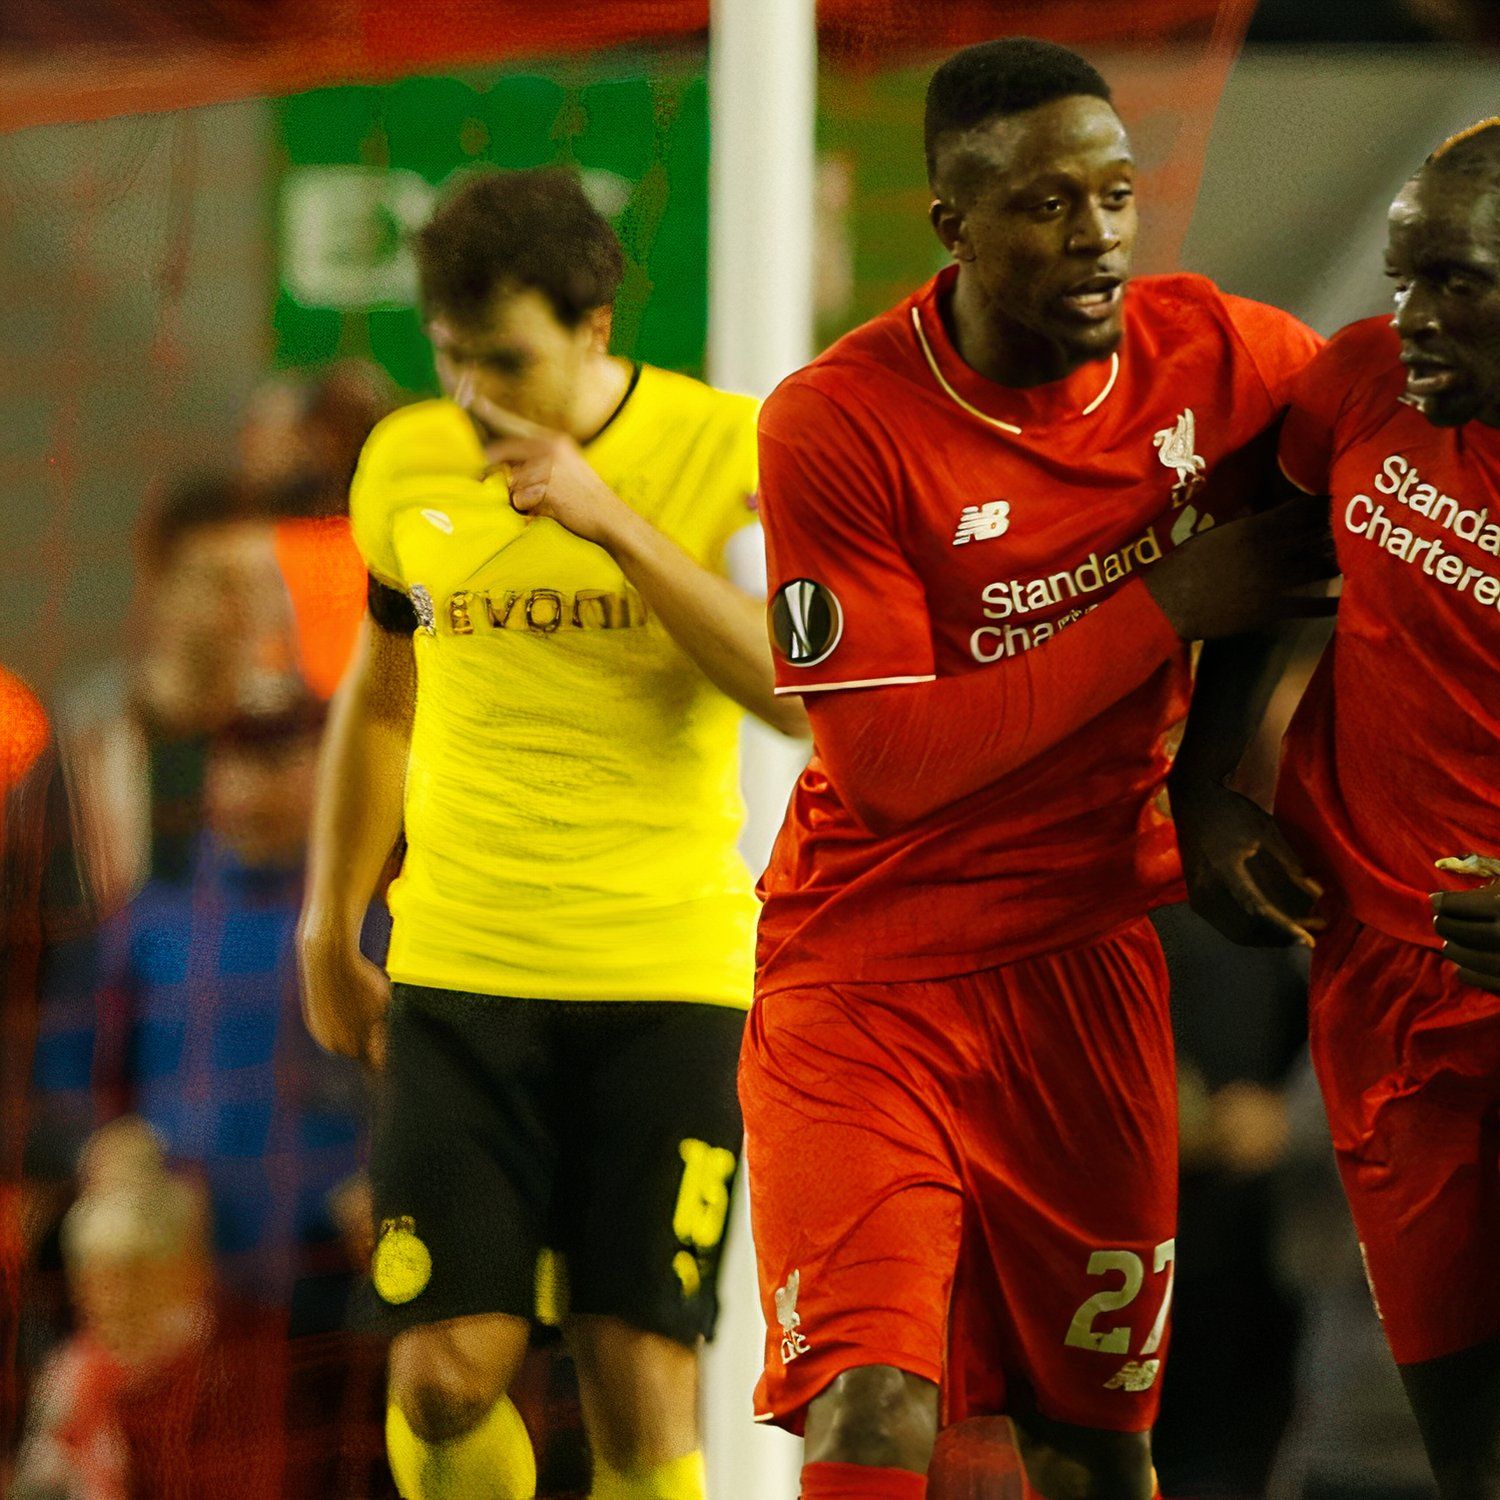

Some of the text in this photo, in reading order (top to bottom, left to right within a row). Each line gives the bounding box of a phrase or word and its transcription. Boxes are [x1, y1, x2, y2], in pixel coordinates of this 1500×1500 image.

[953, 500, 1011, 546] NB
[981, 526, 1164, 620] Standard
[450, 589, 647, 635] EVONI
[1063, 1237, 1176, 1355] 27
